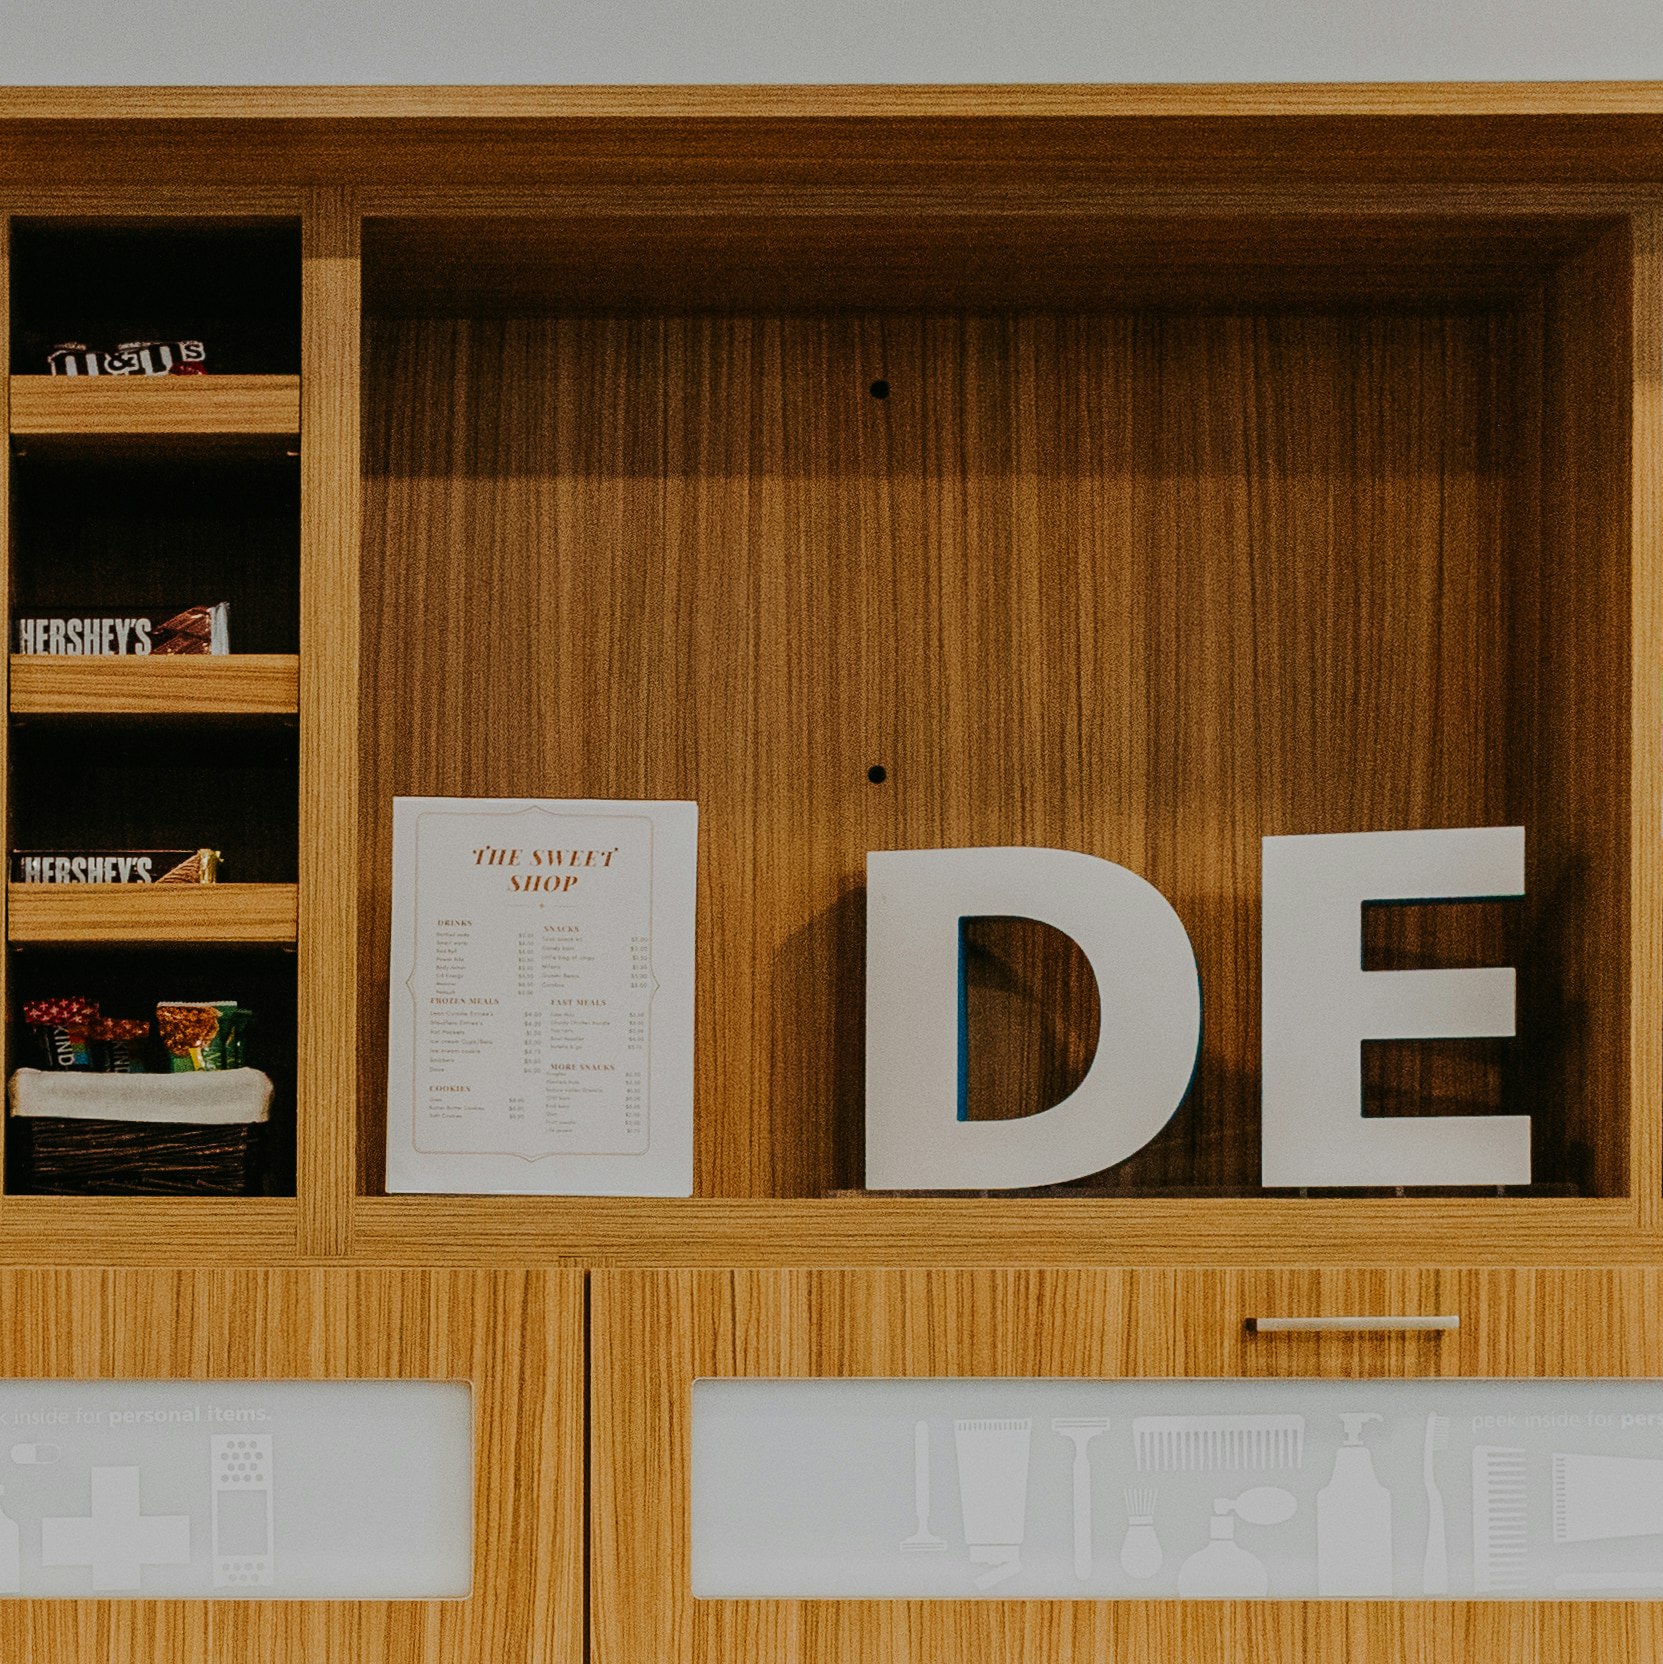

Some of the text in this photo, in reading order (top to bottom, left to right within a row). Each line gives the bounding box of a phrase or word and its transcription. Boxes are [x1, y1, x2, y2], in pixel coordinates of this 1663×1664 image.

[20, 619, 152, 655] HERSHEY'S
[472, 844, 619, 868] THE SWEET
[507, 875, 579, 893] SHOP
[437, 919, 473, 927] DRINKS
[53, 1024, 76, 1067] KIND
[14, 1408, 68, 1425] inside
[76, 1409, 102, 1425] for
[109, 1406, 200, 1429] personal
[206, 1405, 271, 1423] items.
[1472, 1410, 1516, 1431] peek
[1524, 1409, 1580, 1427] inside
[1586, 1409, 1613, 1426] for
